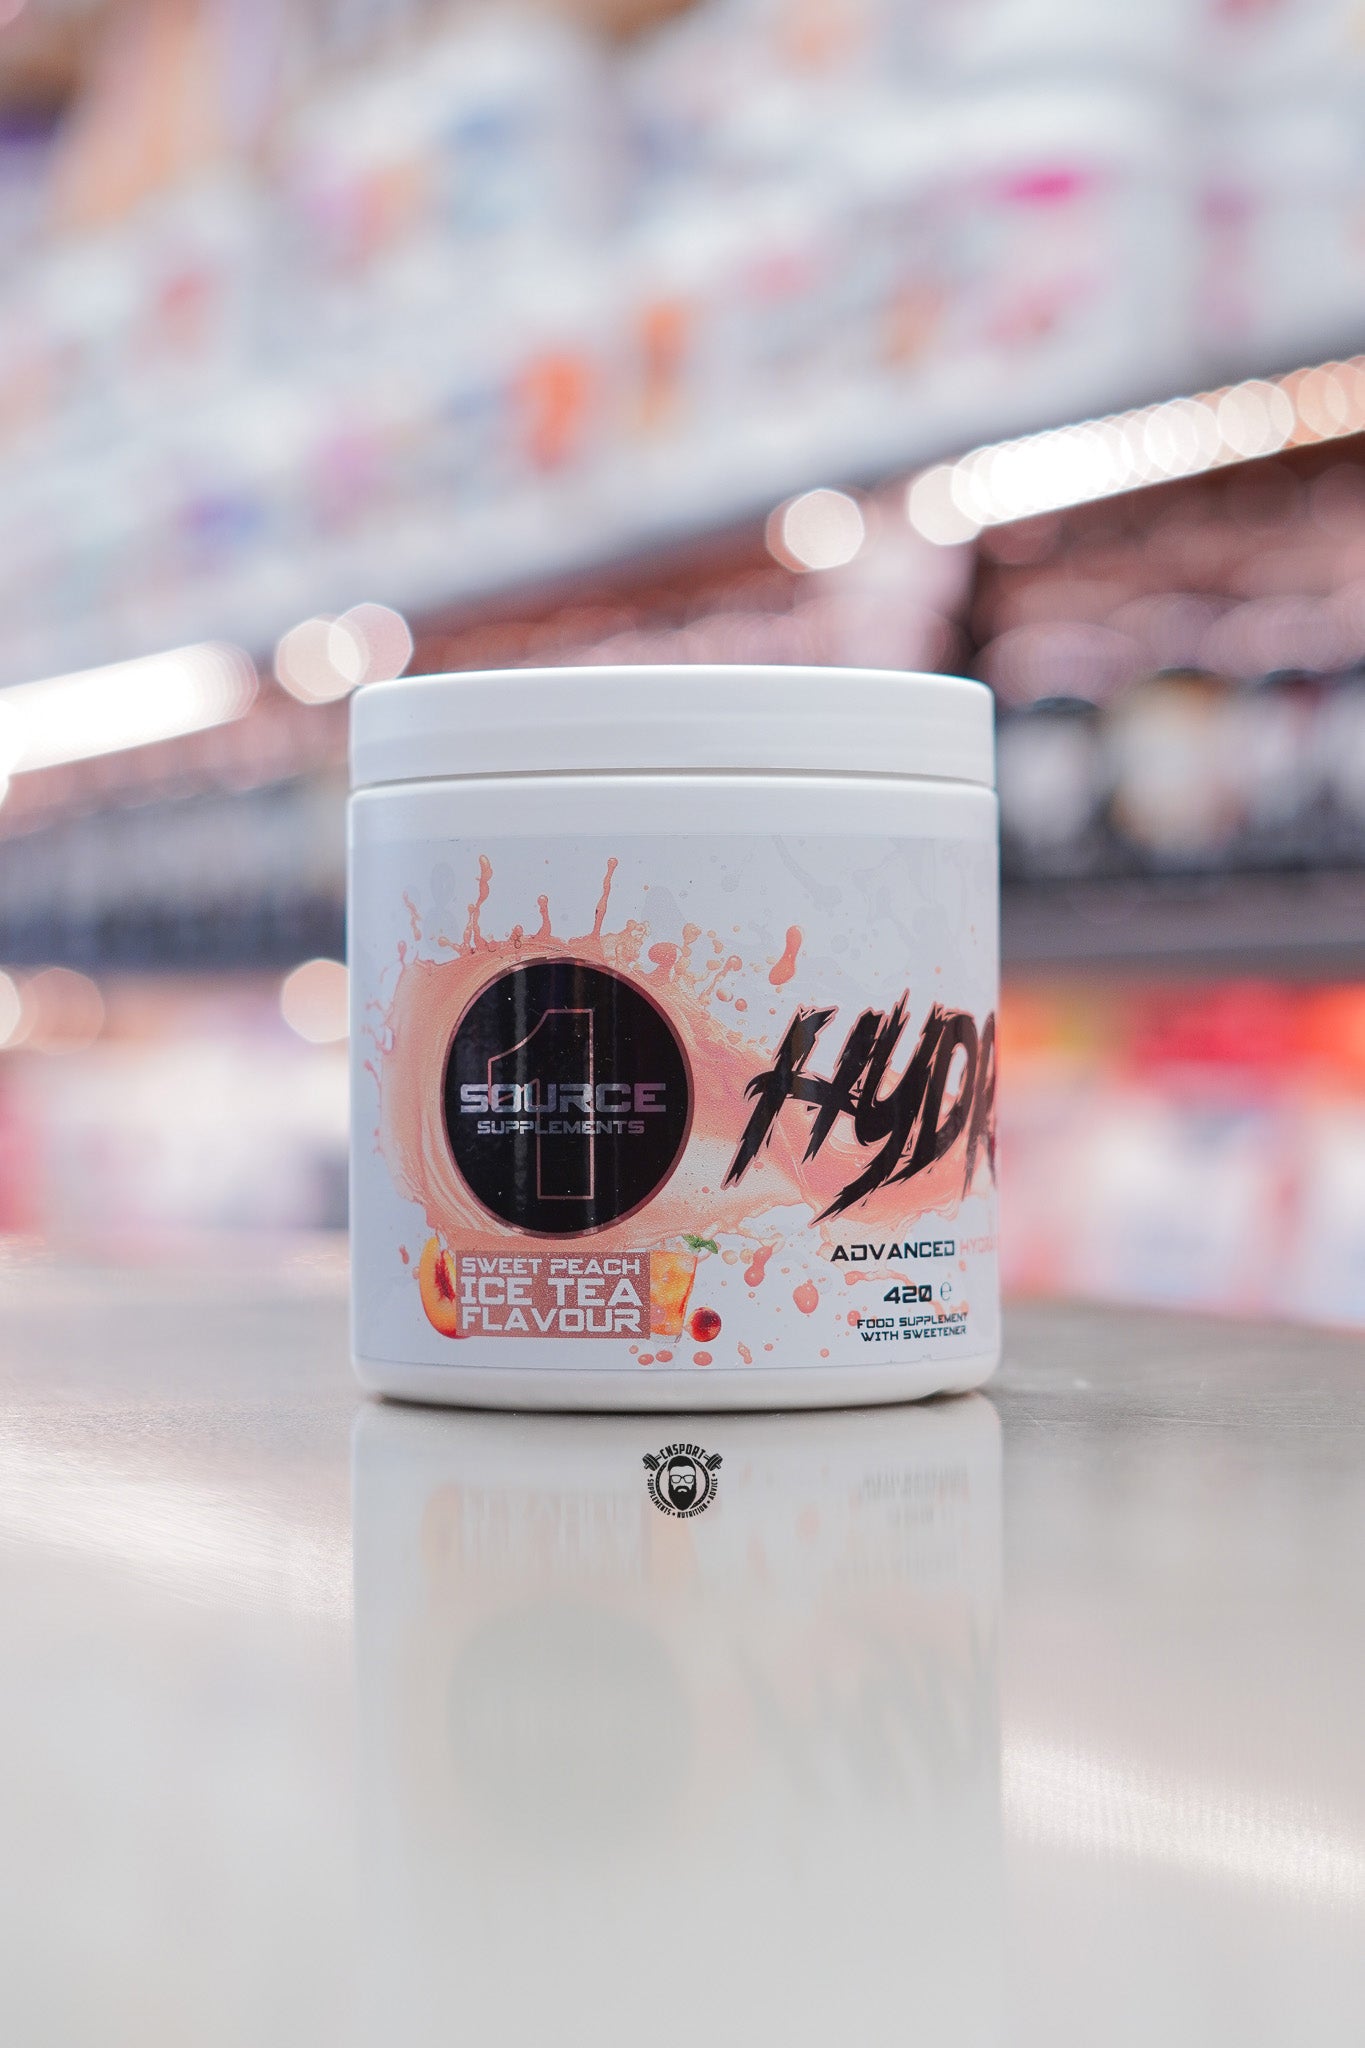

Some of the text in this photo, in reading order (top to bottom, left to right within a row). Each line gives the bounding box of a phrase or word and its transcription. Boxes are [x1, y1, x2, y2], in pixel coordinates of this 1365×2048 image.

[460, 1083, 667, 1113] SOURCE
[477, 1120, 646, 1135] SUPPLEMENTS
[831, 1240, 955, 1262] ADVANCED
[461, 1258, 640, 1275] SWEET PEACH
[460, 1277, 642, 1306] ICE TEA
[883, 1284, 932, 1304] 420
[462, 1307, 642, 1333] FLAVOUR
[857, 1312, 968, 1329] FOOD SUPPLEMENT
[861, 1325, 966, 1341] WITH SWEETENER
